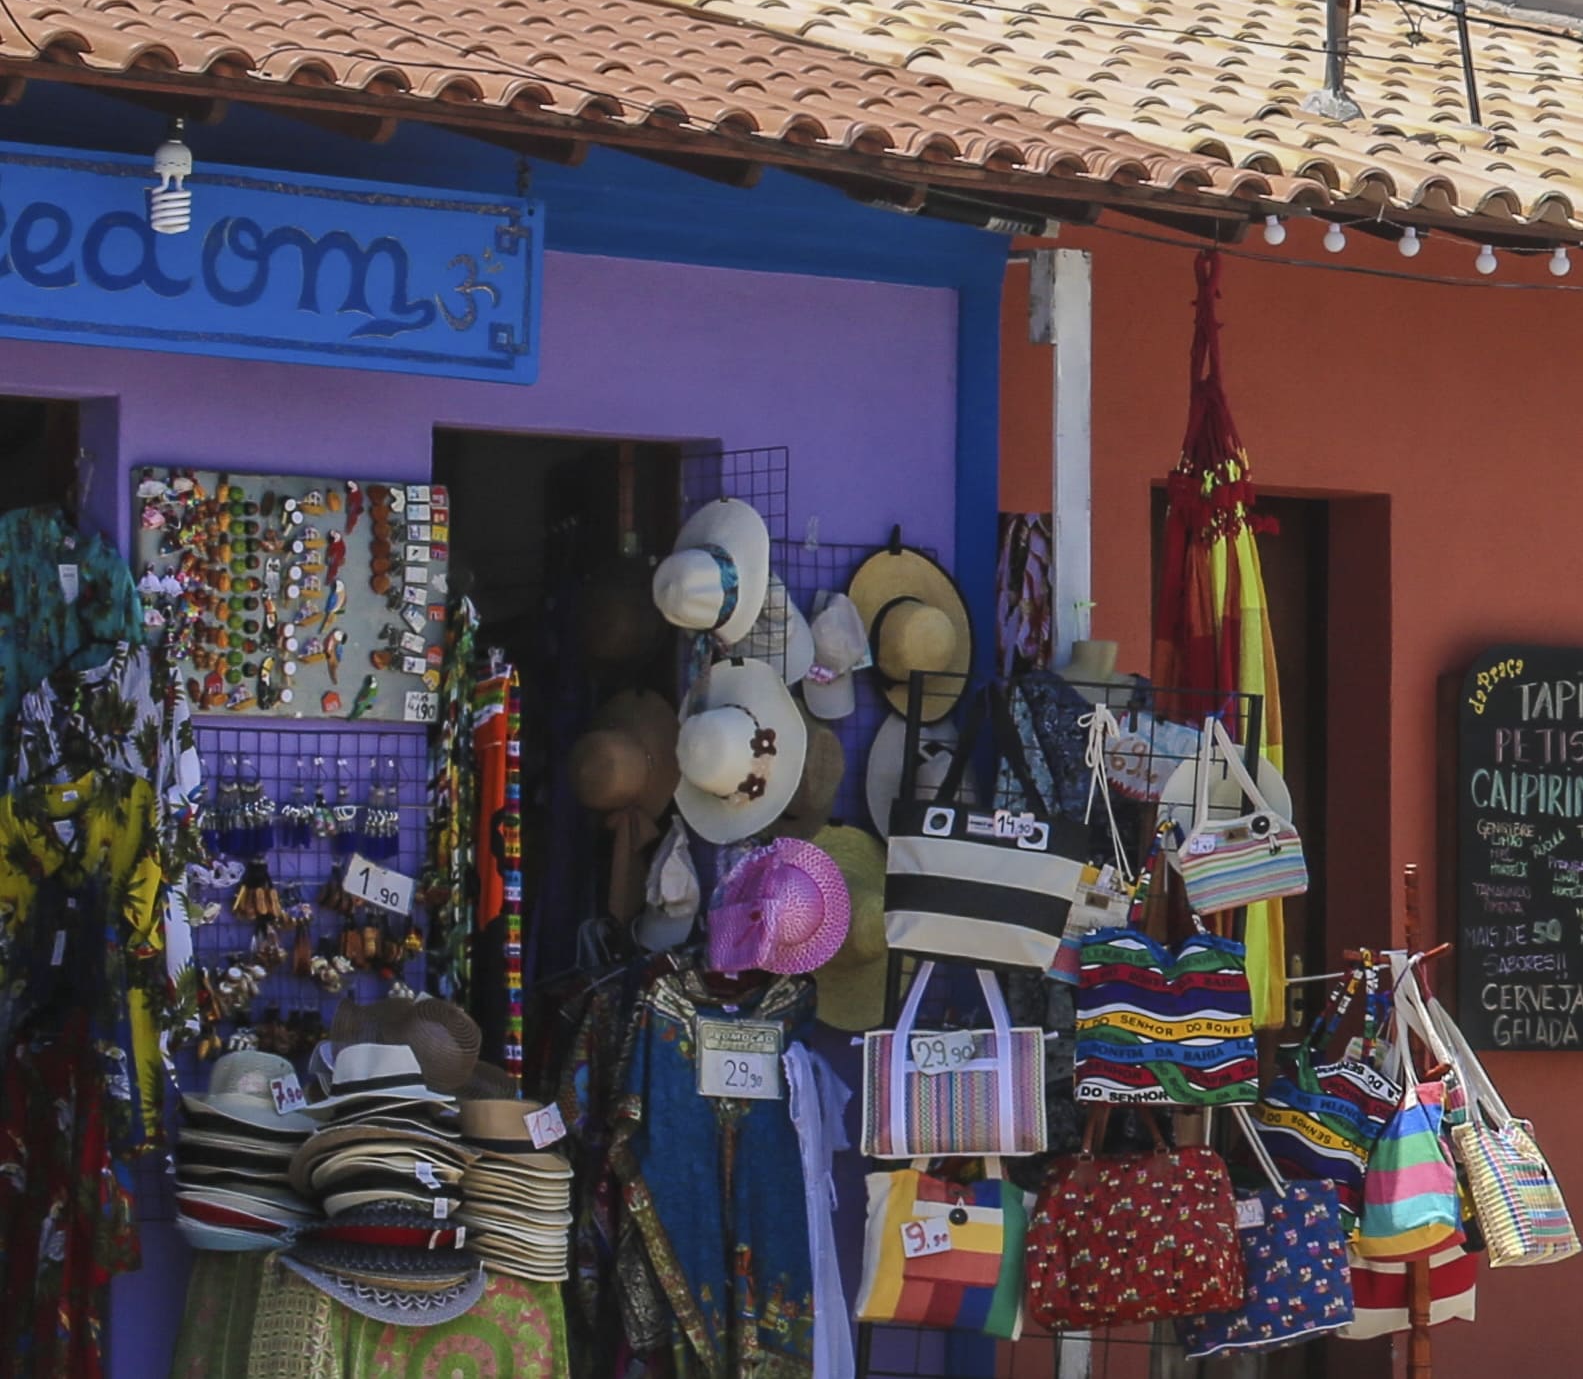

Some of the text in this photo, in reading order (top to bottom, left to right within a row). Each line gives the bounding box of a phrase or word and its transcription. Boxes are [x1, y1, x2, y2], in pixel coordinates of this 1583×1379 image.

[0, 187, 435, 339] edom
[1464, 918, 1562, 949] MAIS DE 50
[1120, 1013, 1174, 1037] SENHOR
[1185, 1023, 1202, 1034] DO
[1493, 1013, 1580, 1047] GELADA
[1080, 1085, 1170, 1104] DO SENHOR
